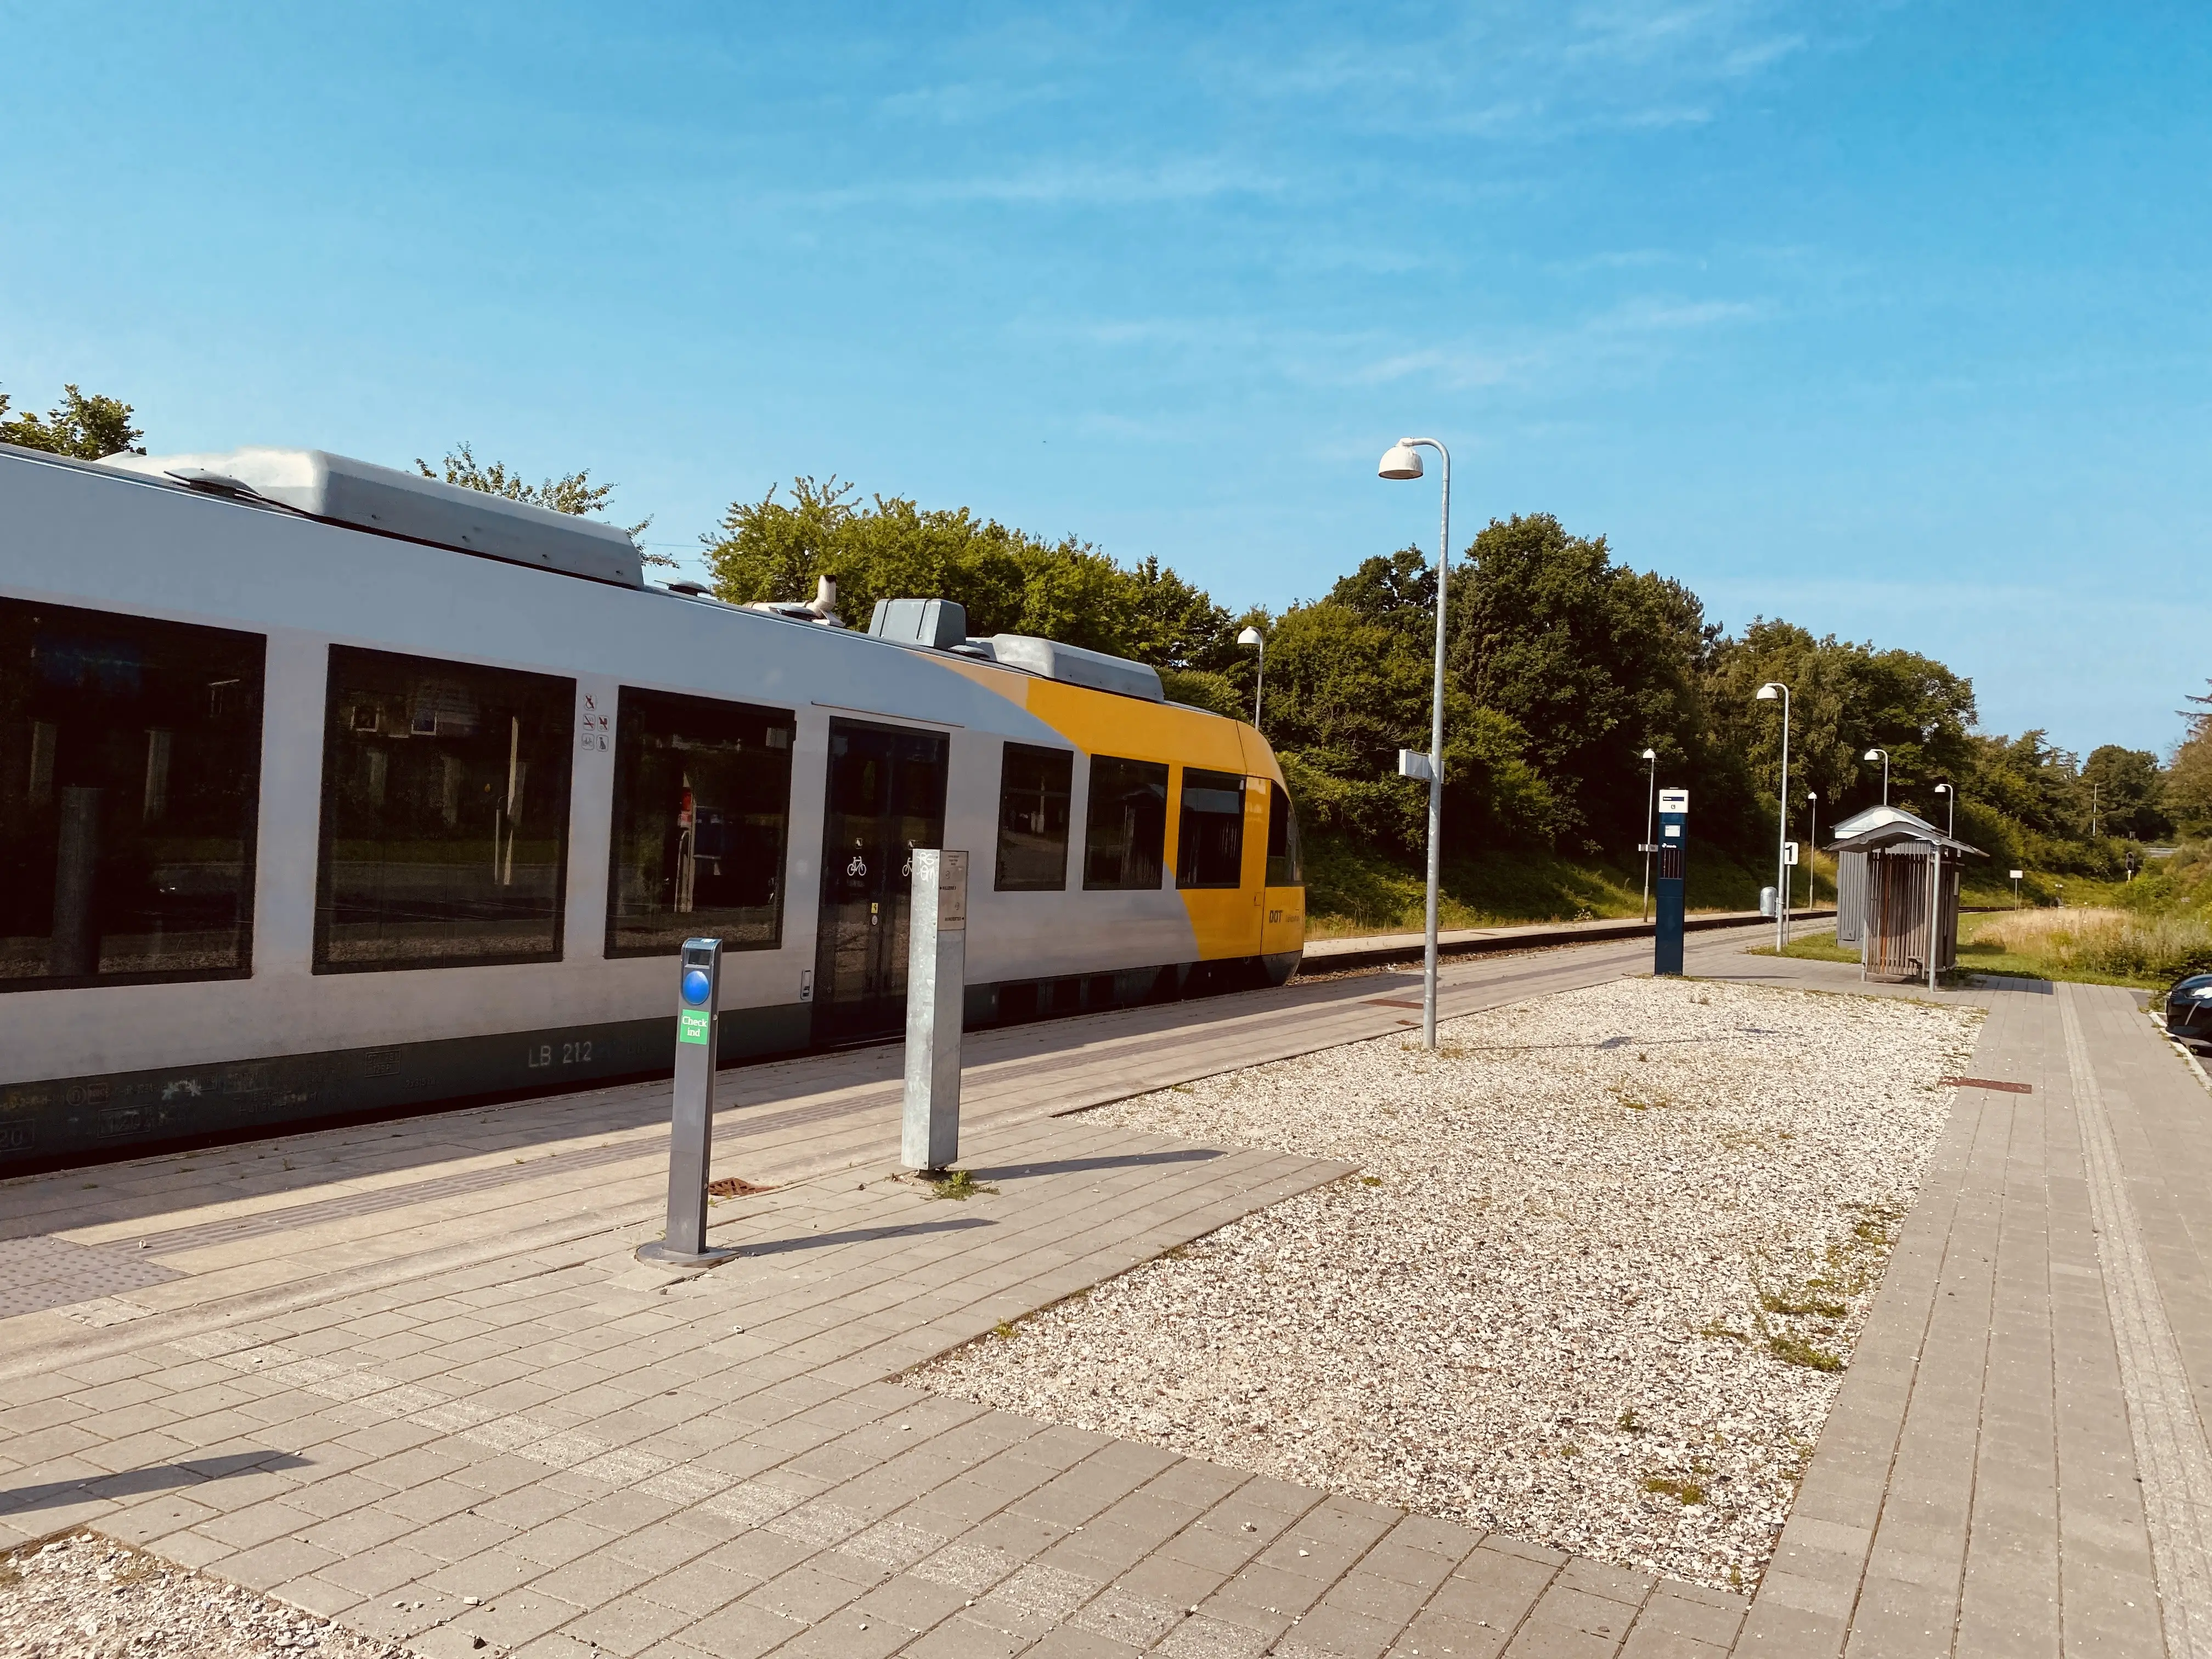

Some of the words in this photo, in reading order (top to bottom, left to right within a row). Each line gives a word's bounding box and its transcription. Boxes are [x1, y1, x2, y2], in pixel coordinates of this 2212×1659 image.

[1785, 845, 1792, 861] 1
[1269, 910, 1283, 923] DOT
[682, 1015, 707, 1028] Check
[687, 1027, 701, 1037] ind
[528, 1045, 551, 1068] LB
[562, 1041, 592, 1064] 212
